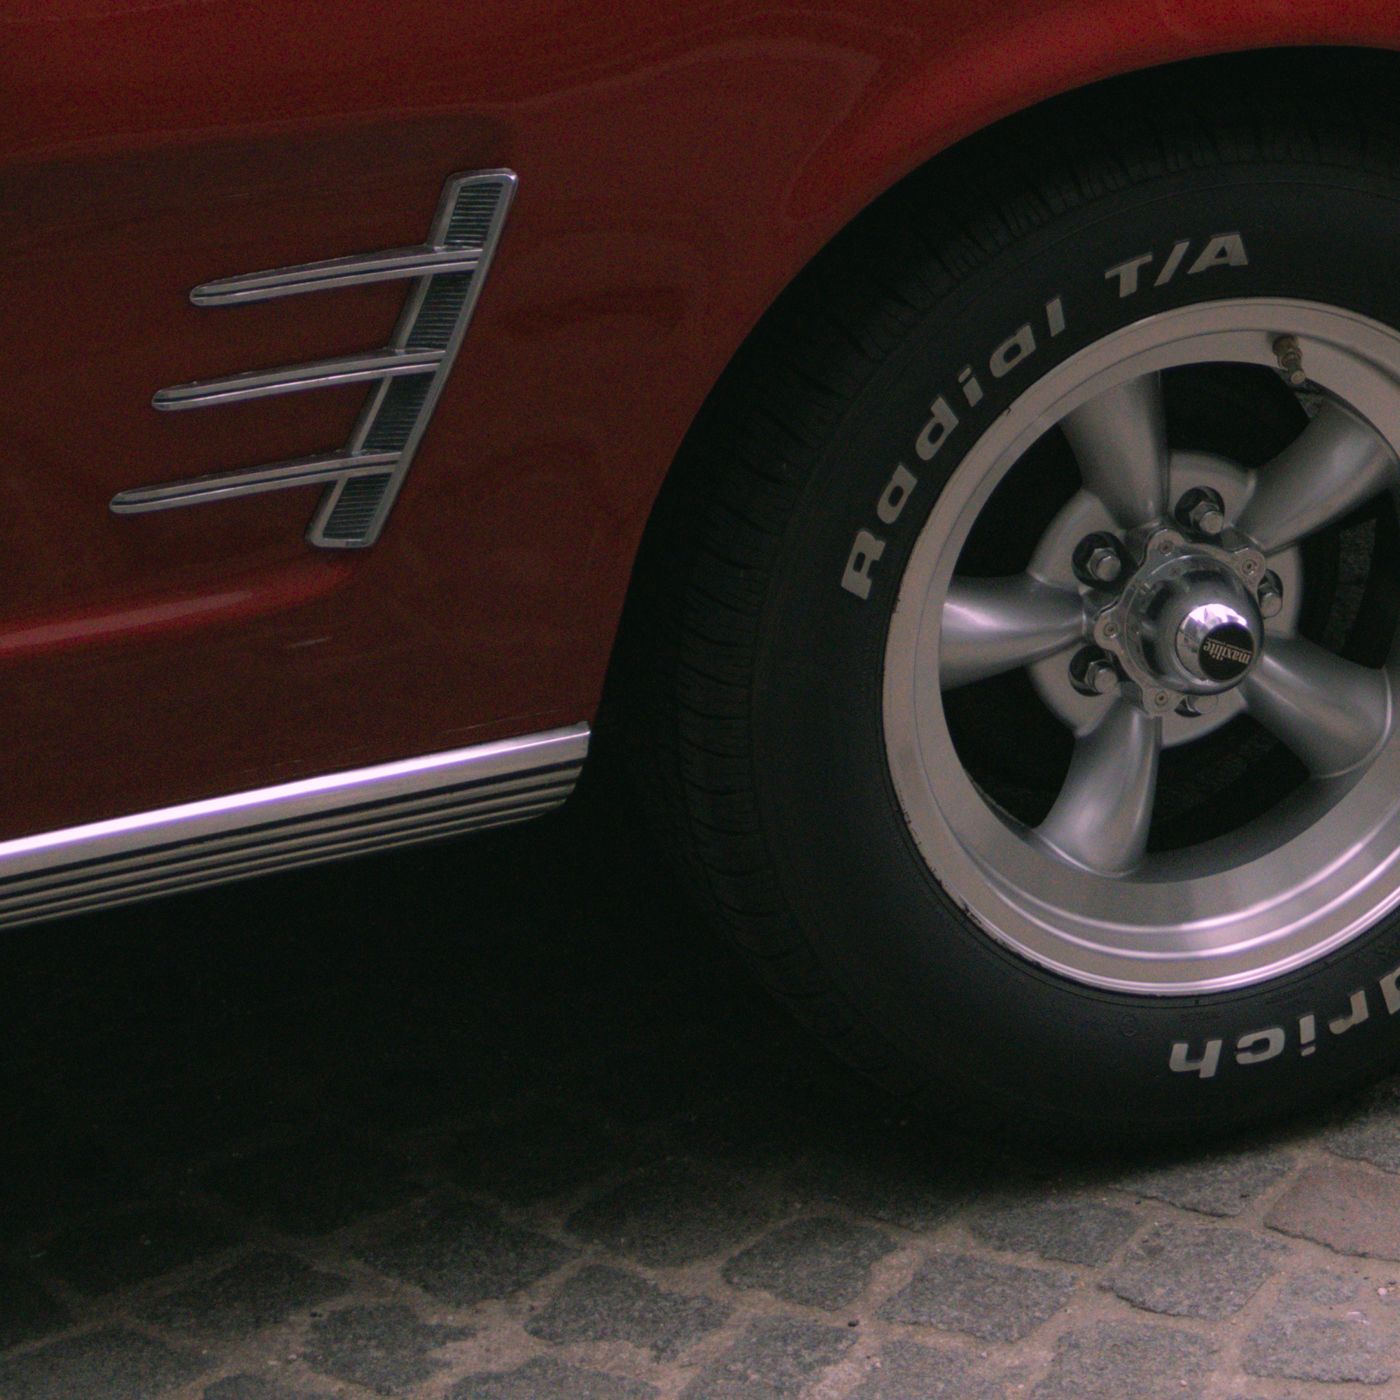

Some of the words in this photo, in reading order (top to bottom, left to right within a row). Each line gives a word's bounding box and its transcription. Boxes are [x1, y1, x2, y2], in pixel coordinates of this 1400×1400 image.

[840, 296, 1065, 600] Radial
[1105, 232, 1249, 298] T/A
[1203, 641, 1251, 665] maxilite
